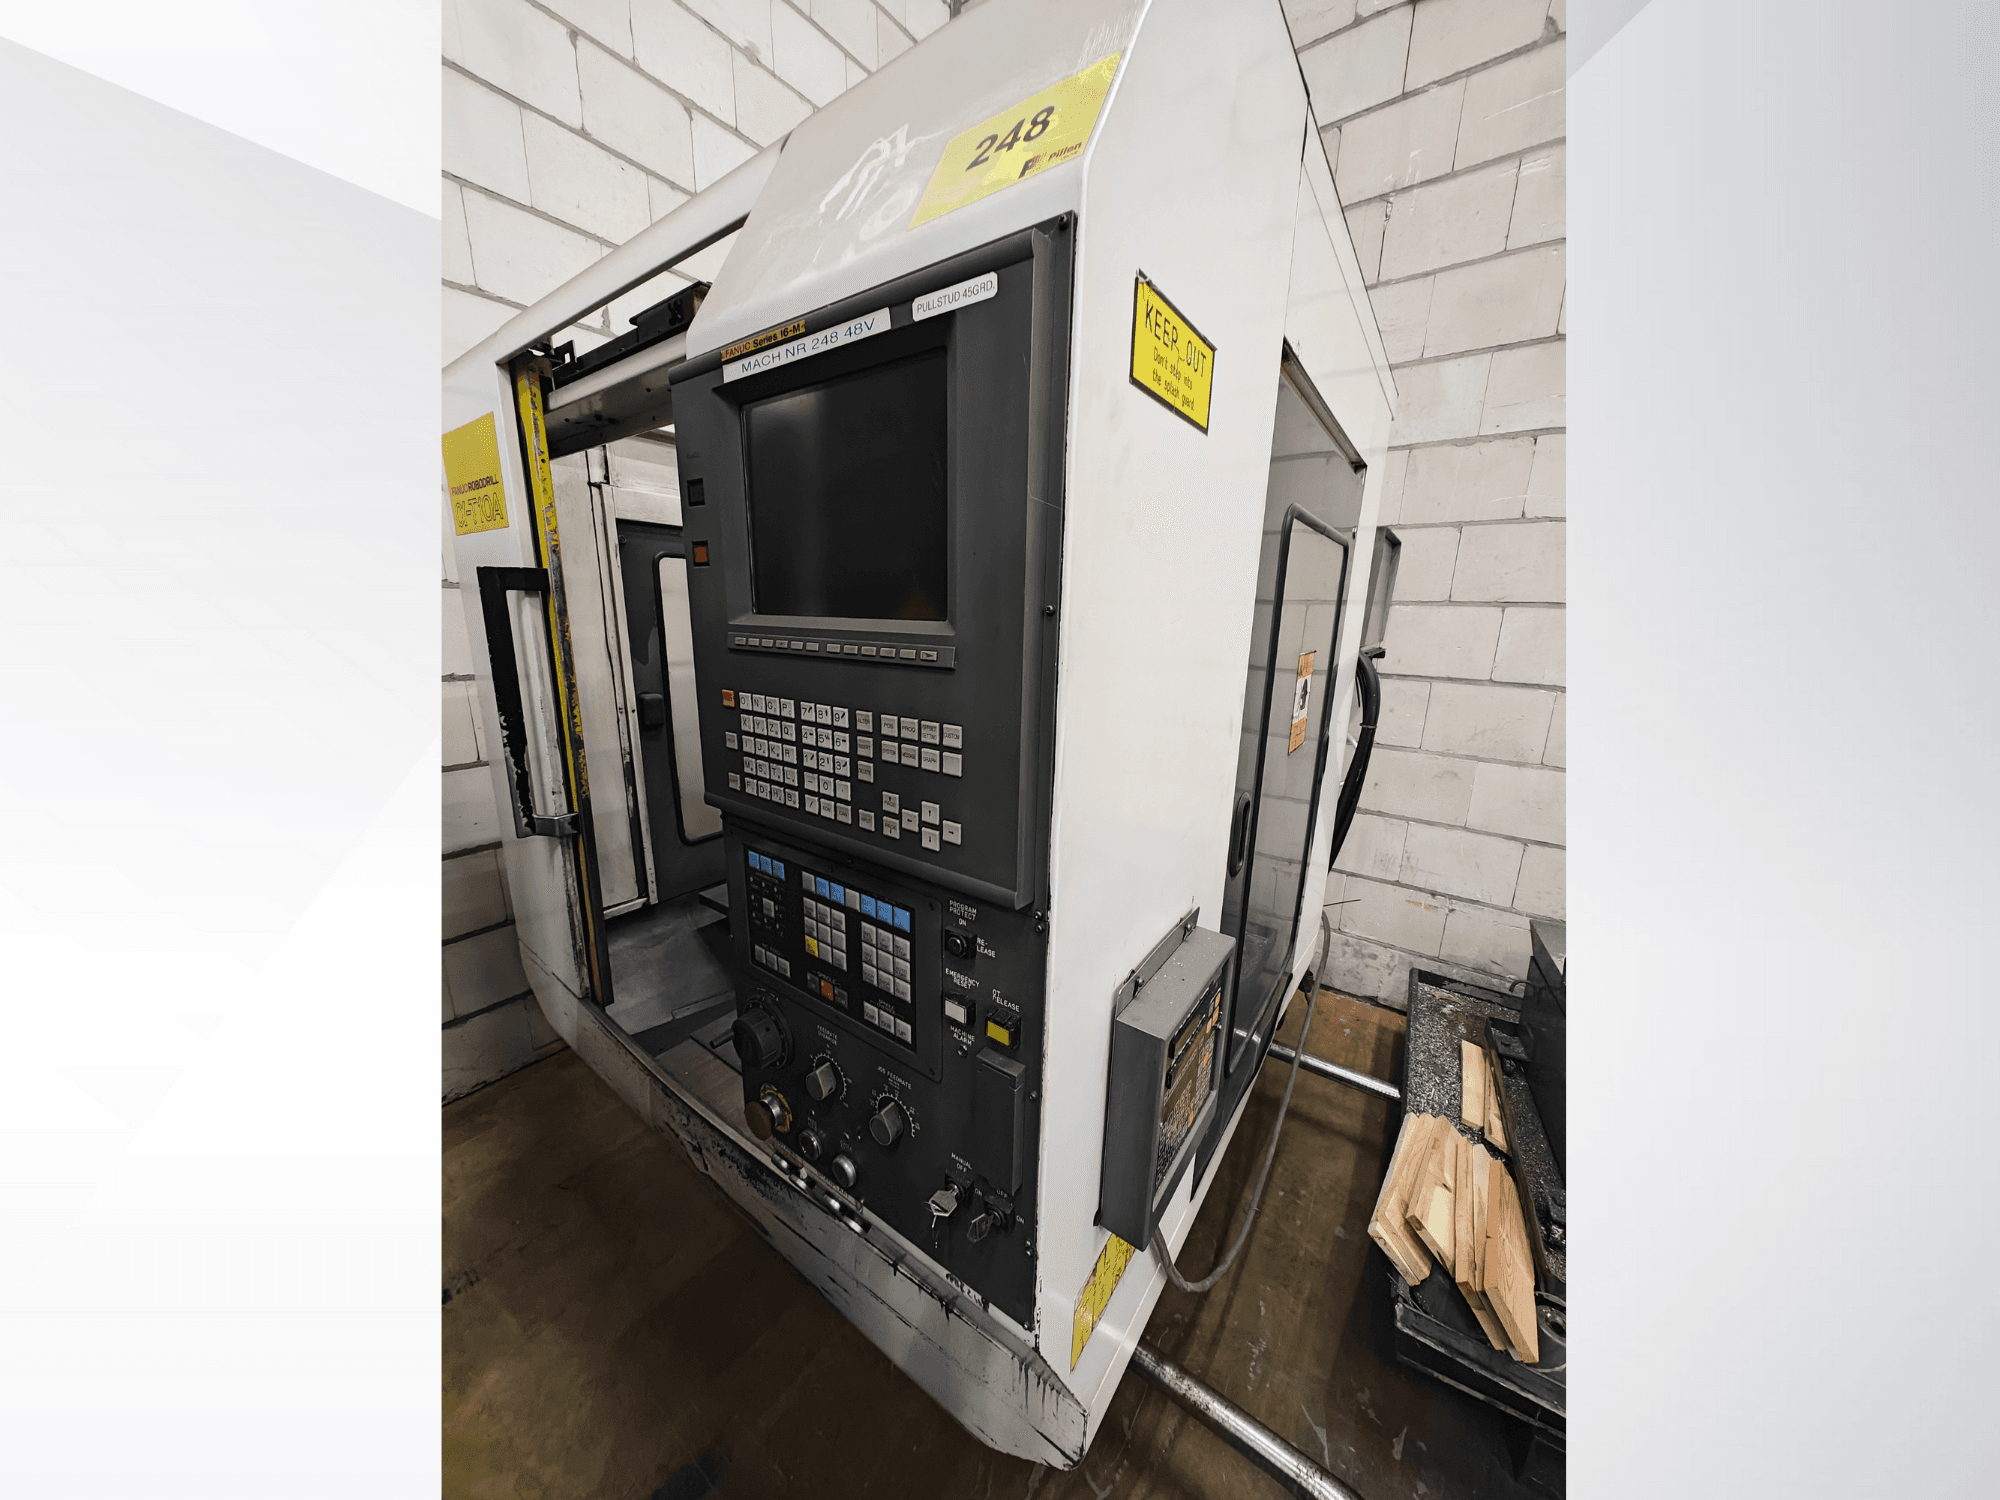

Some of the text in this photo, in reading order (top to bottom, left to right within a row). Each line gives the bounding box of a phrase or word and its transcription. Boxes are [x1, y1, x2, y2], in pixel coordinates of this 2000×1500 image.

[965, 105, 1055, 172] 248
[917, 280, 995, 314] PULLSTUD 45GRD.
[725, 323, 800, 358] FANUC Series 16-M
[741, 317, 875, 373] MACH NR 248 48V
[1145, 298, 1206, 377] KEEP OUT
[1154, 346, 1168, 370] Don't
[1170, 364, 1182, 383] step
[1152, 368, 1162, 386] the
[1164, 380, 1179, 400] splash
[949, 900, 977, 914] PROGRAM
[949, 906, 976, 921] PROTECT
[958, 918, 967, 926] ON
[977, 937, 988, 946] RE-
[977, 946, 996, 958] LEASE
[945, 968, 979, 988] EMERGENCY
[953, 977, 972, 990] RESET
[992, 995, 1020, 1012] RELEASE
[817, 1024, 838, 1039] FEEDRATE
[950, 1025, 975, 1042] MACHINE
[953, 1033, 972, 1046] ALARM
[887, 1070, 912, 1090] FEEDRATE
